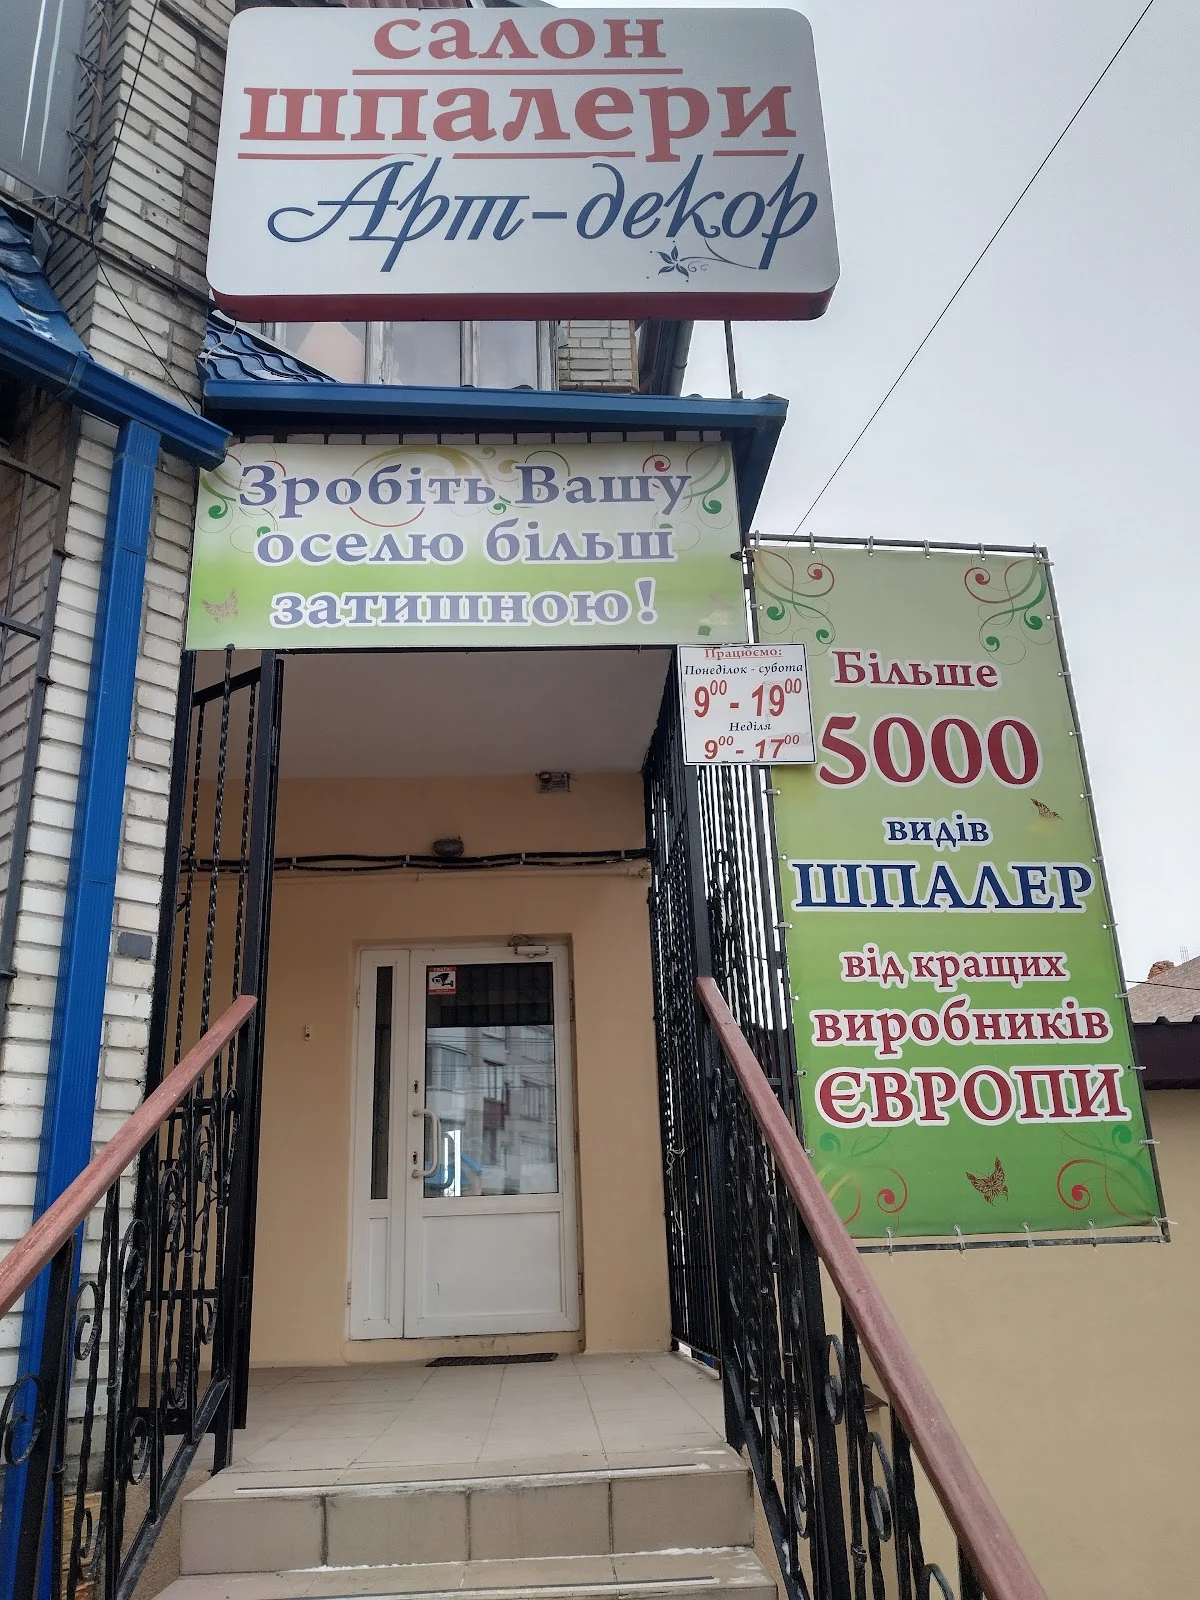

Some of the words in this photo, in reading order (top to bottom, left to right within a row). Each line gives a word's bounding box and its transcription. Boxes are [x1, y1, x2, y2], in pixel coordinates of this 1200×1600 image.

[373, 18, 667, 60] салон
[240, 85, 797, 162] шпалери
[267, 153, 818, 272] Арт-декор
[239, 463, 495, 518] Зробіть
[514, 465, 691, 514] Вашу
[257, 530, 464, 563] оселю
[487, 517, 675, 562] більш
[272, 579, 657, 625] затишною!
[684, 664, 748, 676] Понеділок
[758, 662, 803, 676] субота
[704, 647, 782, 660] Працюємо:
[832, 650, 998, 688] Більше
[729, 721, 771, 732] Неділя
[818, 715, 1039, 785] 5000
[886, 814, 990, 848] видів
[792, 863, 1092, 909] ШПАЛЕР
[843, 947, 905, 984] від
[913, 955, 1067, 988] кращих
[813, 998, 1109, 1056] виробників
[819, 1068, 1128, 1124] ЄВРОПИ
